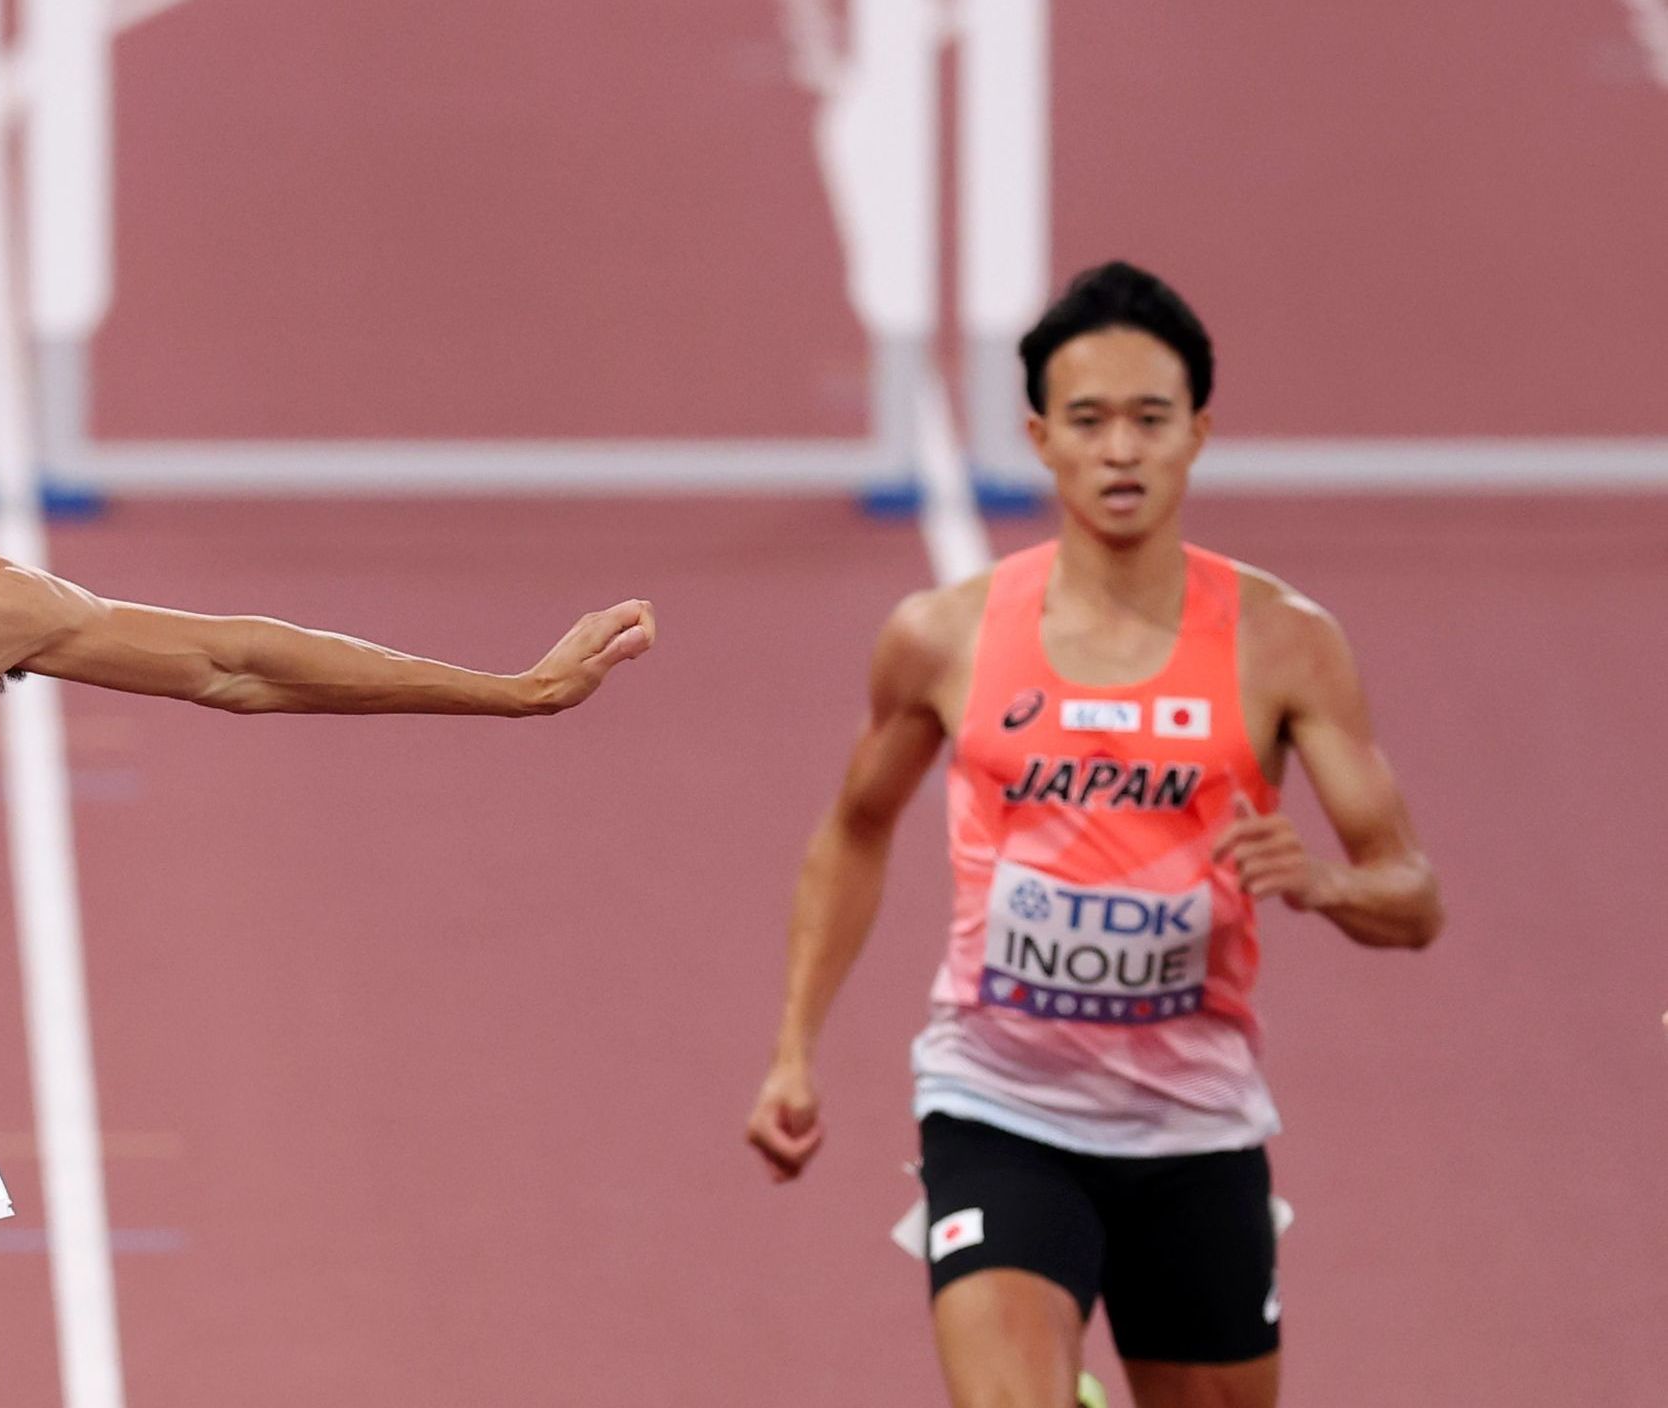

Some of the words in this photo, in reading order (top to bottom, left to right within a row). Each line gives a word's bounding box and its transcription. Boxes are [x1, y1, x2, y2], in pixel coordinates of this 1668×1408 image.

[1004, 758, 1201, 808] JAPAN
[1056, 889, 1193, 936] TDK
[1004, 930, 1191, 988] INOUE
